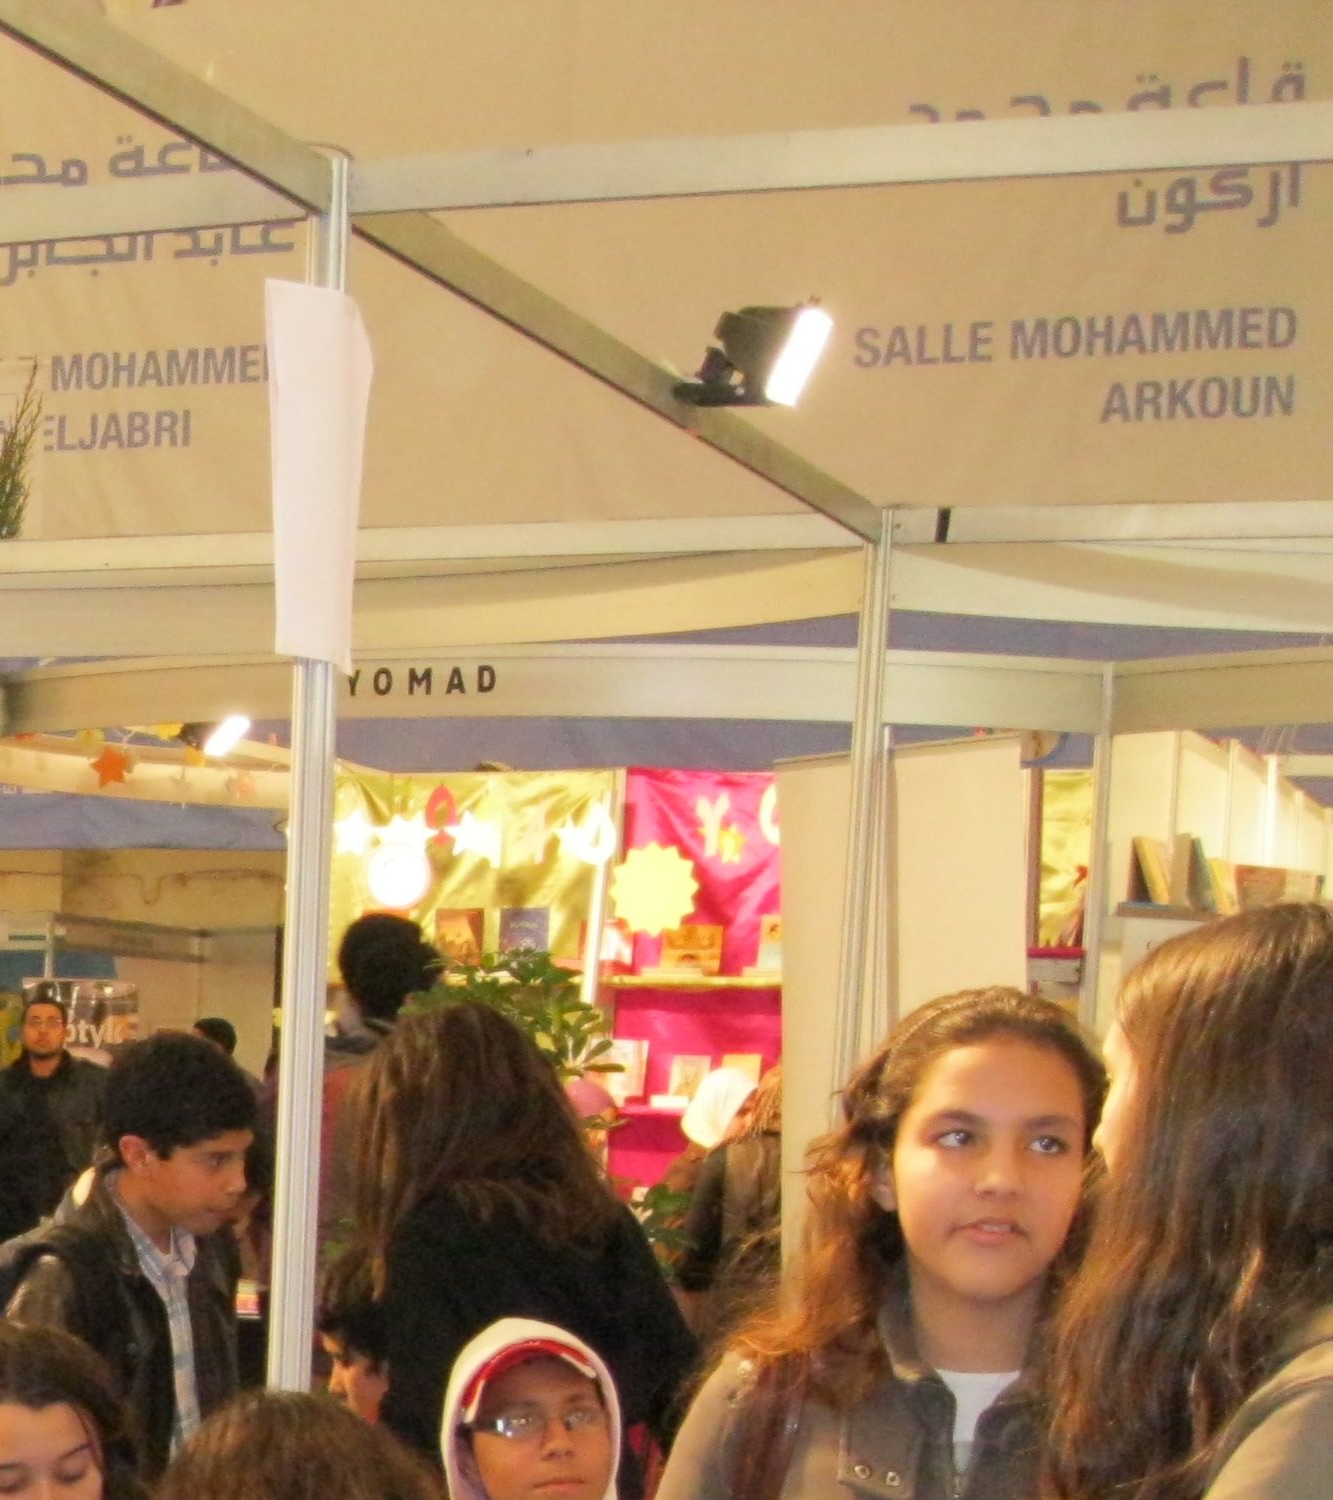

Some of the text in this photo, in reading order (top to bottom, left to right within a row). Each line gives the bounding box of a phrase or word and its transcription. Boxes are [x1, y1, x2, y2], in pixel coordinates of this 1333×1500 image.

[853, 306, 1298, 368] SALLE MOHAMMED
[1099, 375, 1296, 423] ARKOUN
[348, 664, 497, 697] YOMAD
